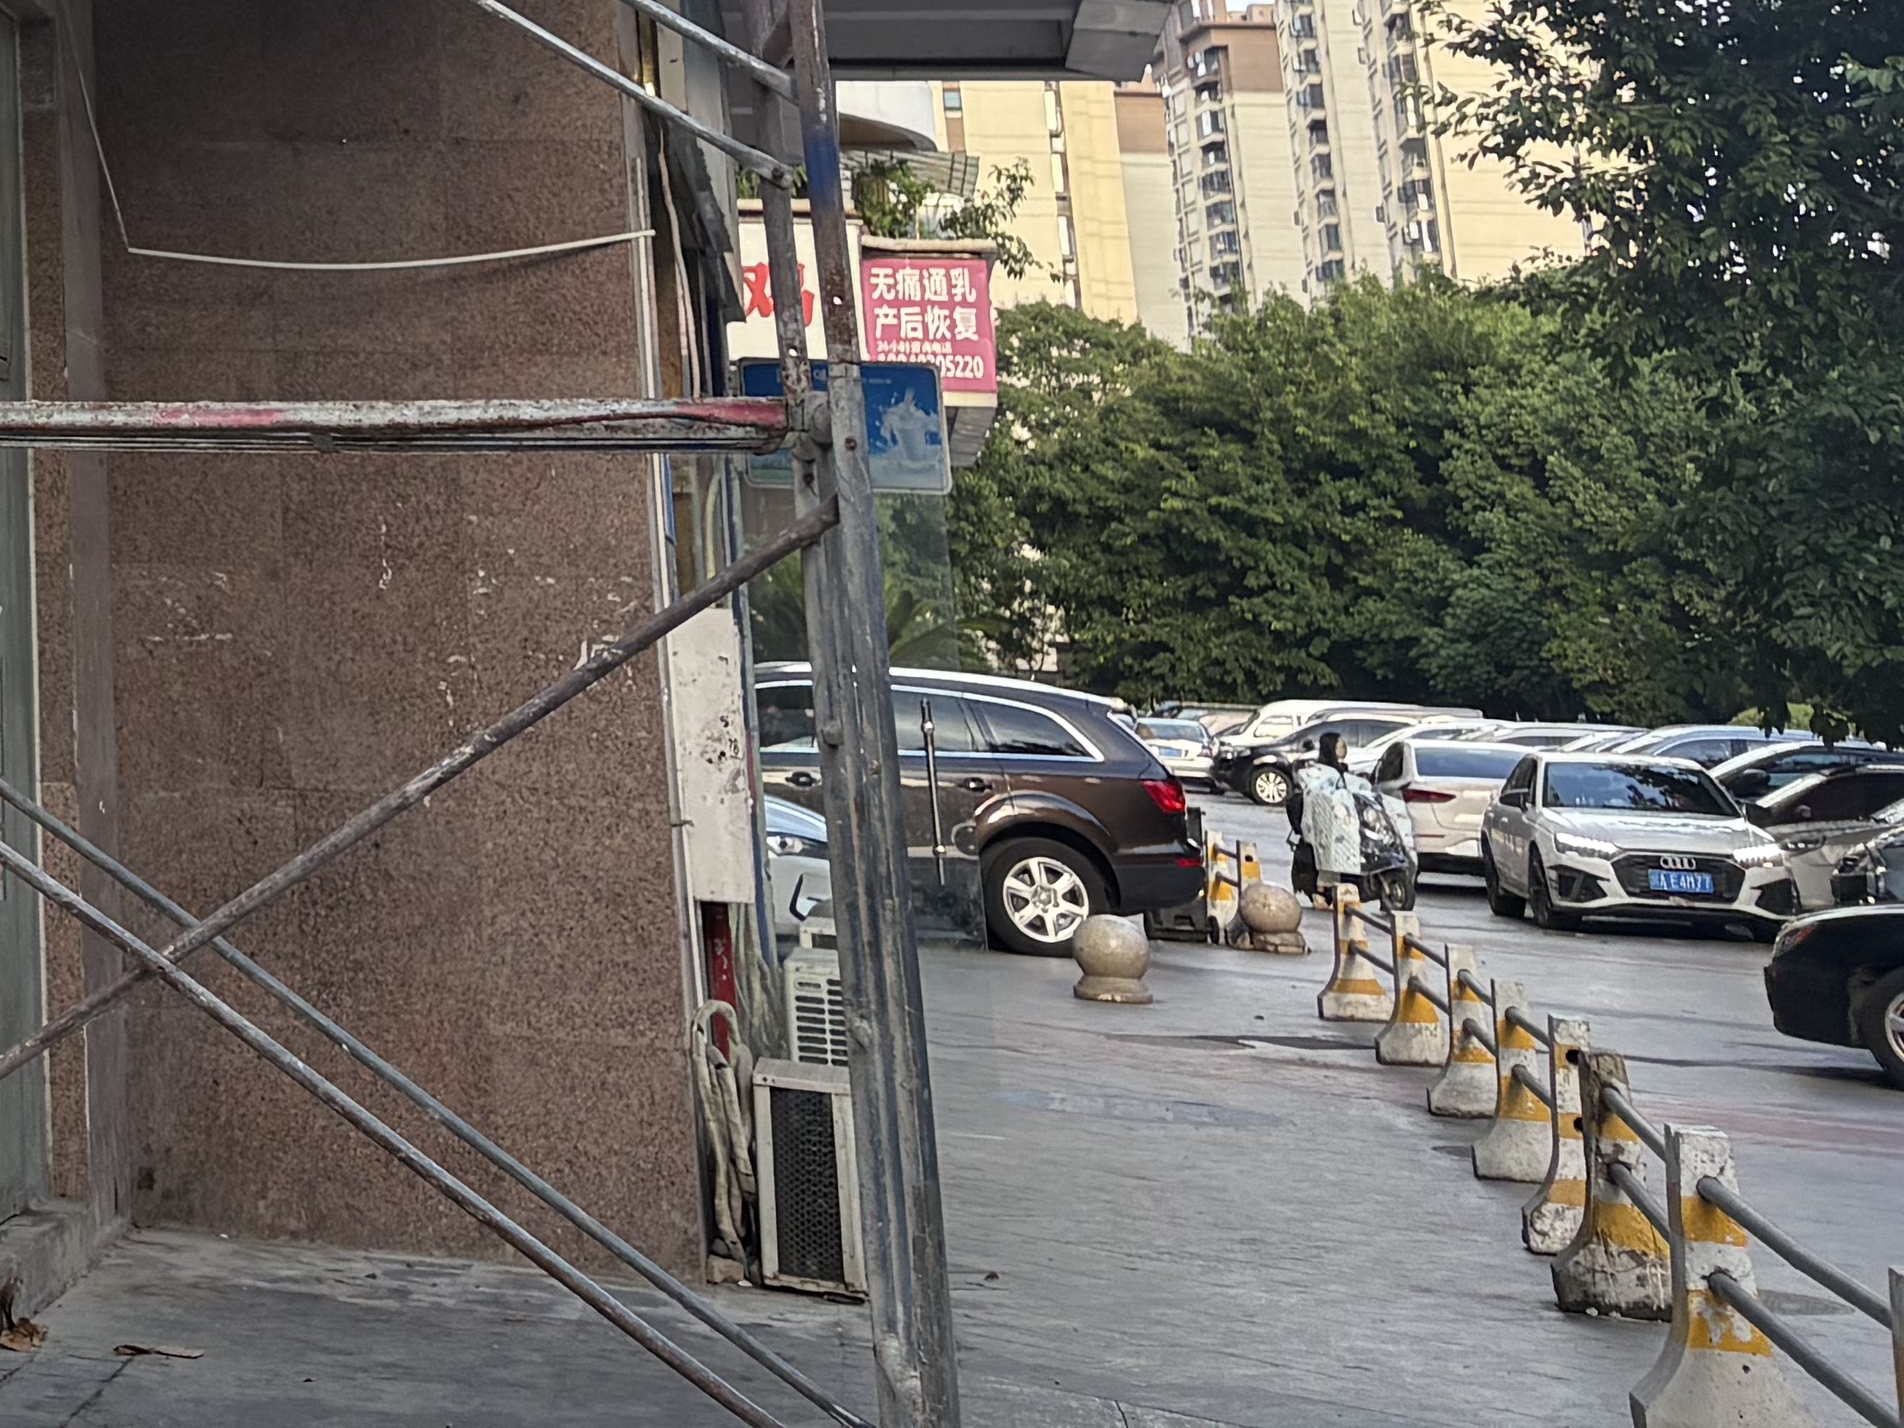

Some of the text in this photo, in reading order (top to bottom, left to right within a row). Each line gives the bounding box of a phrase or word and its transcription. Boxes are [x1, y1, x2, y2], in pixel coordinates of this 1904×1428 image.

[869, 265, 977, 303] 无痛通乳
[873, 304, 979, 341] 产后恢复
